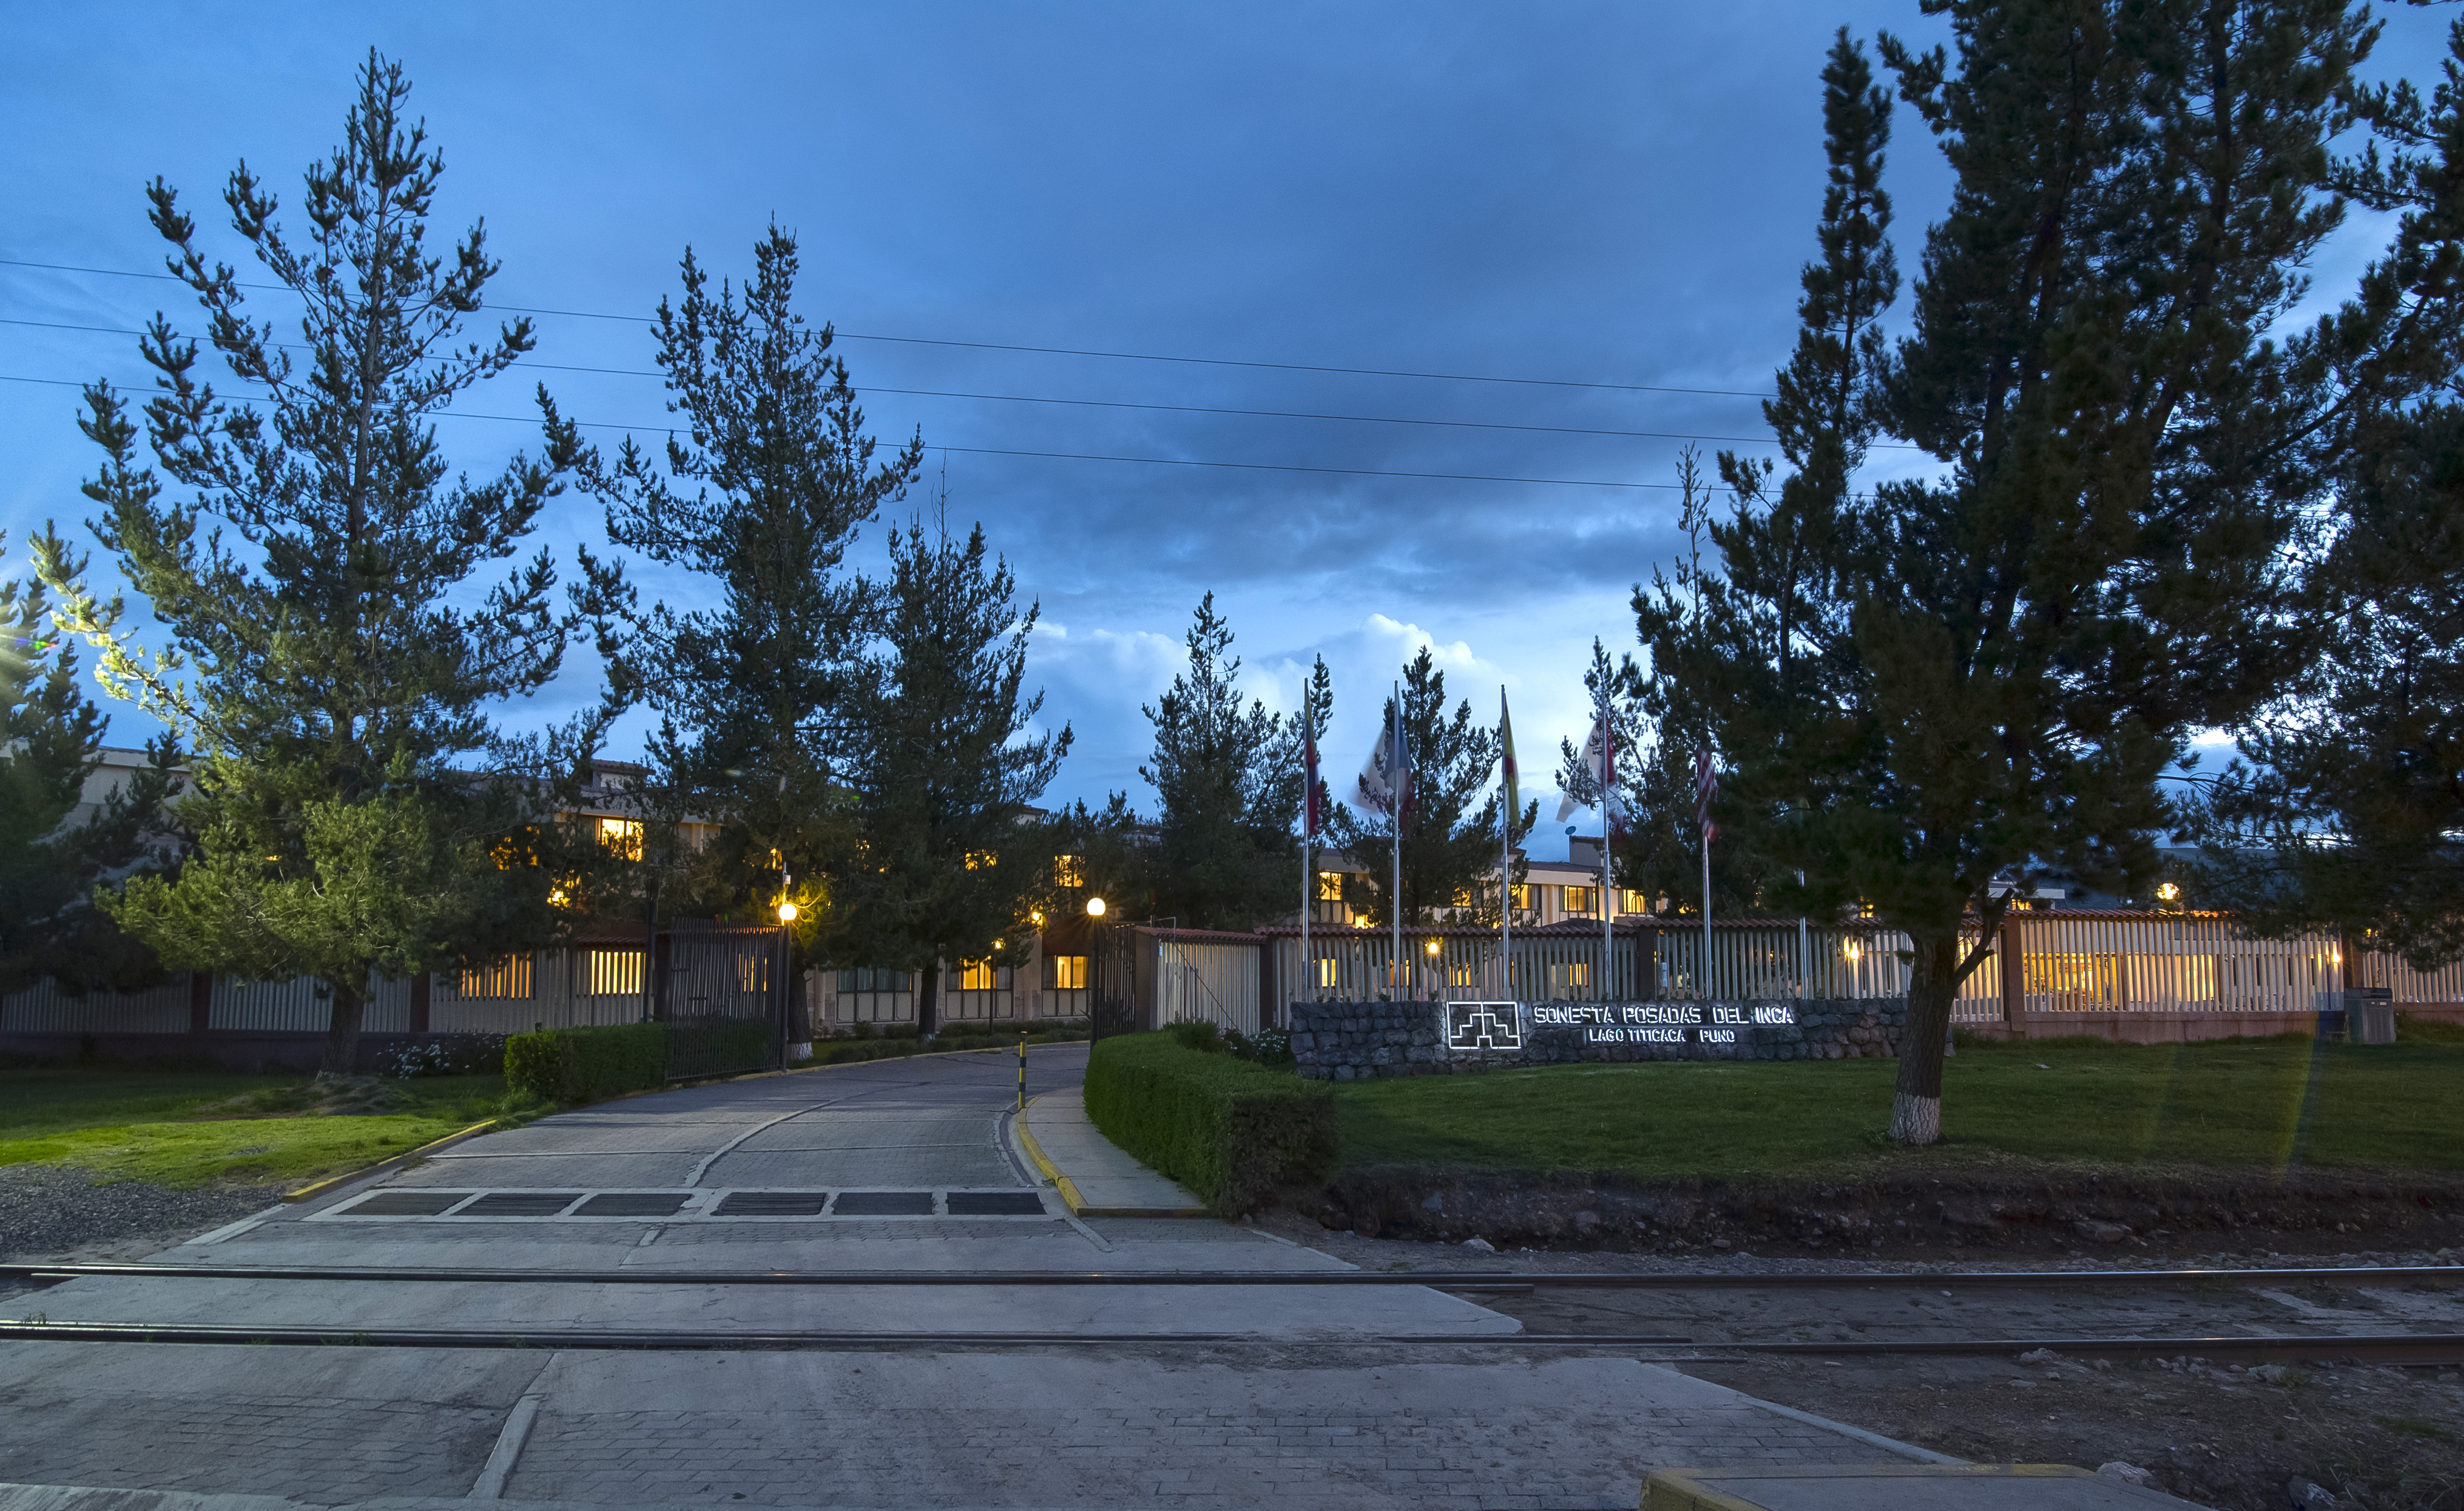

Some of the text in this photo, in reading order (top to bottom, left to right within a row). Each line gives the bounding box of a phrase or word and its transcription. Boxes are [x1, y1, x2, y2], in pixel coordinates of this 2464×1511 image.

[1534, 1006, 1794, 1024] SONESTA POSADAS DEL INCA
[1589, 1028, 1735, 1043] LAGO TITICACA PUNO
